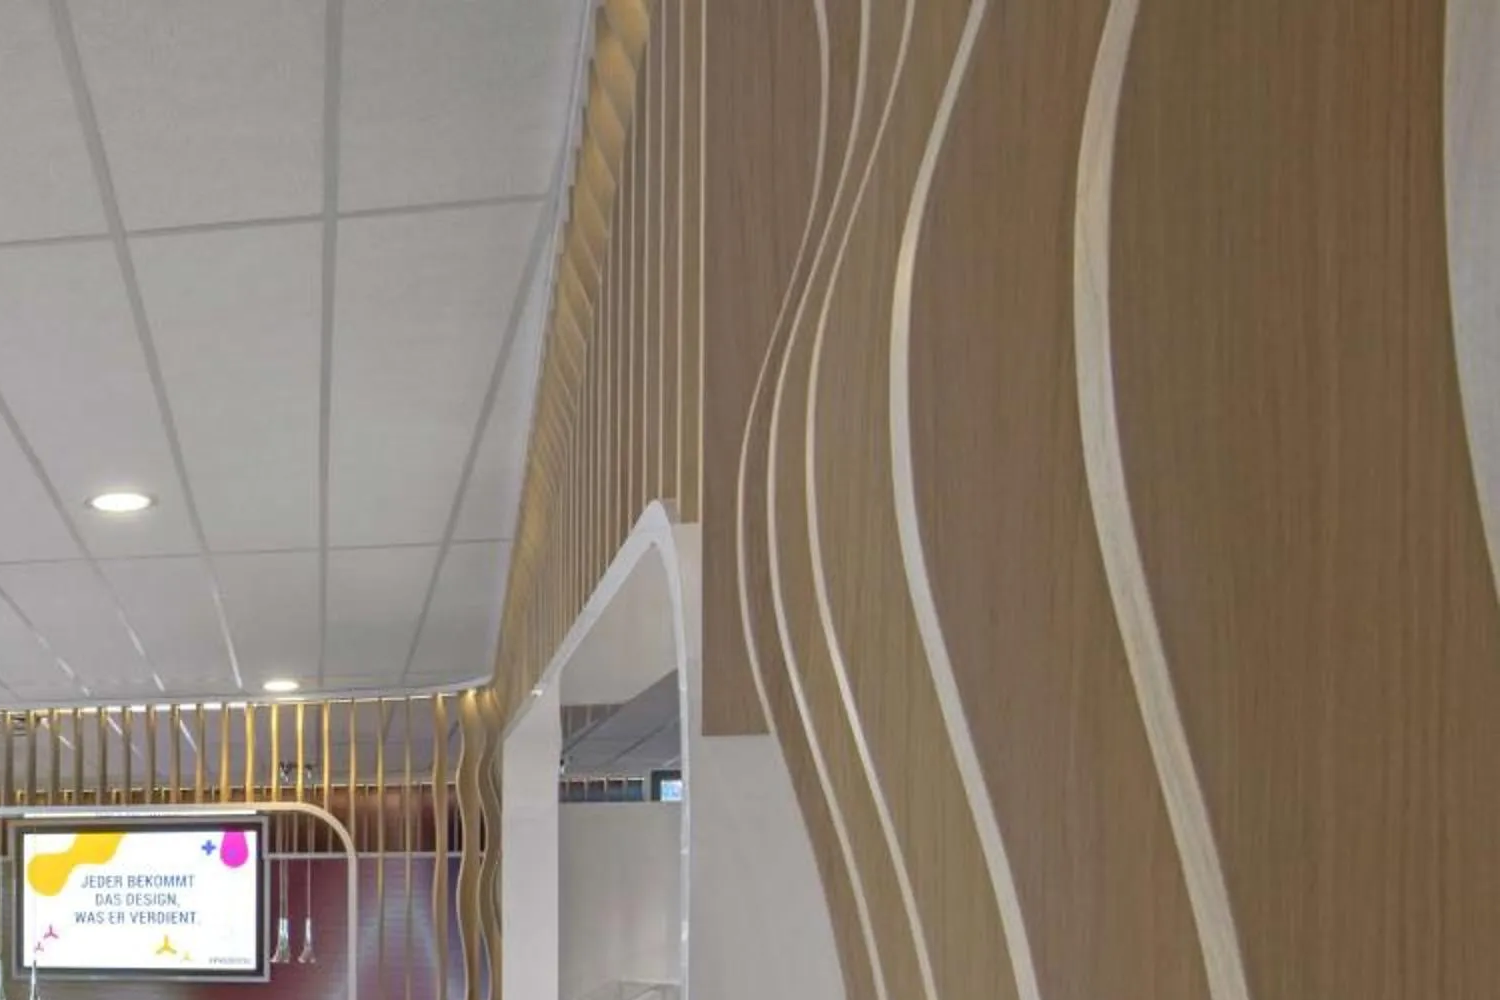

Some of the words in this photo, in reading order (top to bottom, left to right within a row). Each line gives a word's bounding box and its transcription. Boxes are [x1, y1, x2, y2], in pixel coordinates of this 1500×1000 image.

[80, 874, 123, 889] JEDER
[127, 874, 195, 889] BEKOMMT
[95, 892, 122, 907] DAS
[125, 892, 181, 908] DESIGN,
[74, 911, 105, 925] WAS
[108, 911, 125, 925] ER
[129, 911, 202, 926] VERDIENT.
